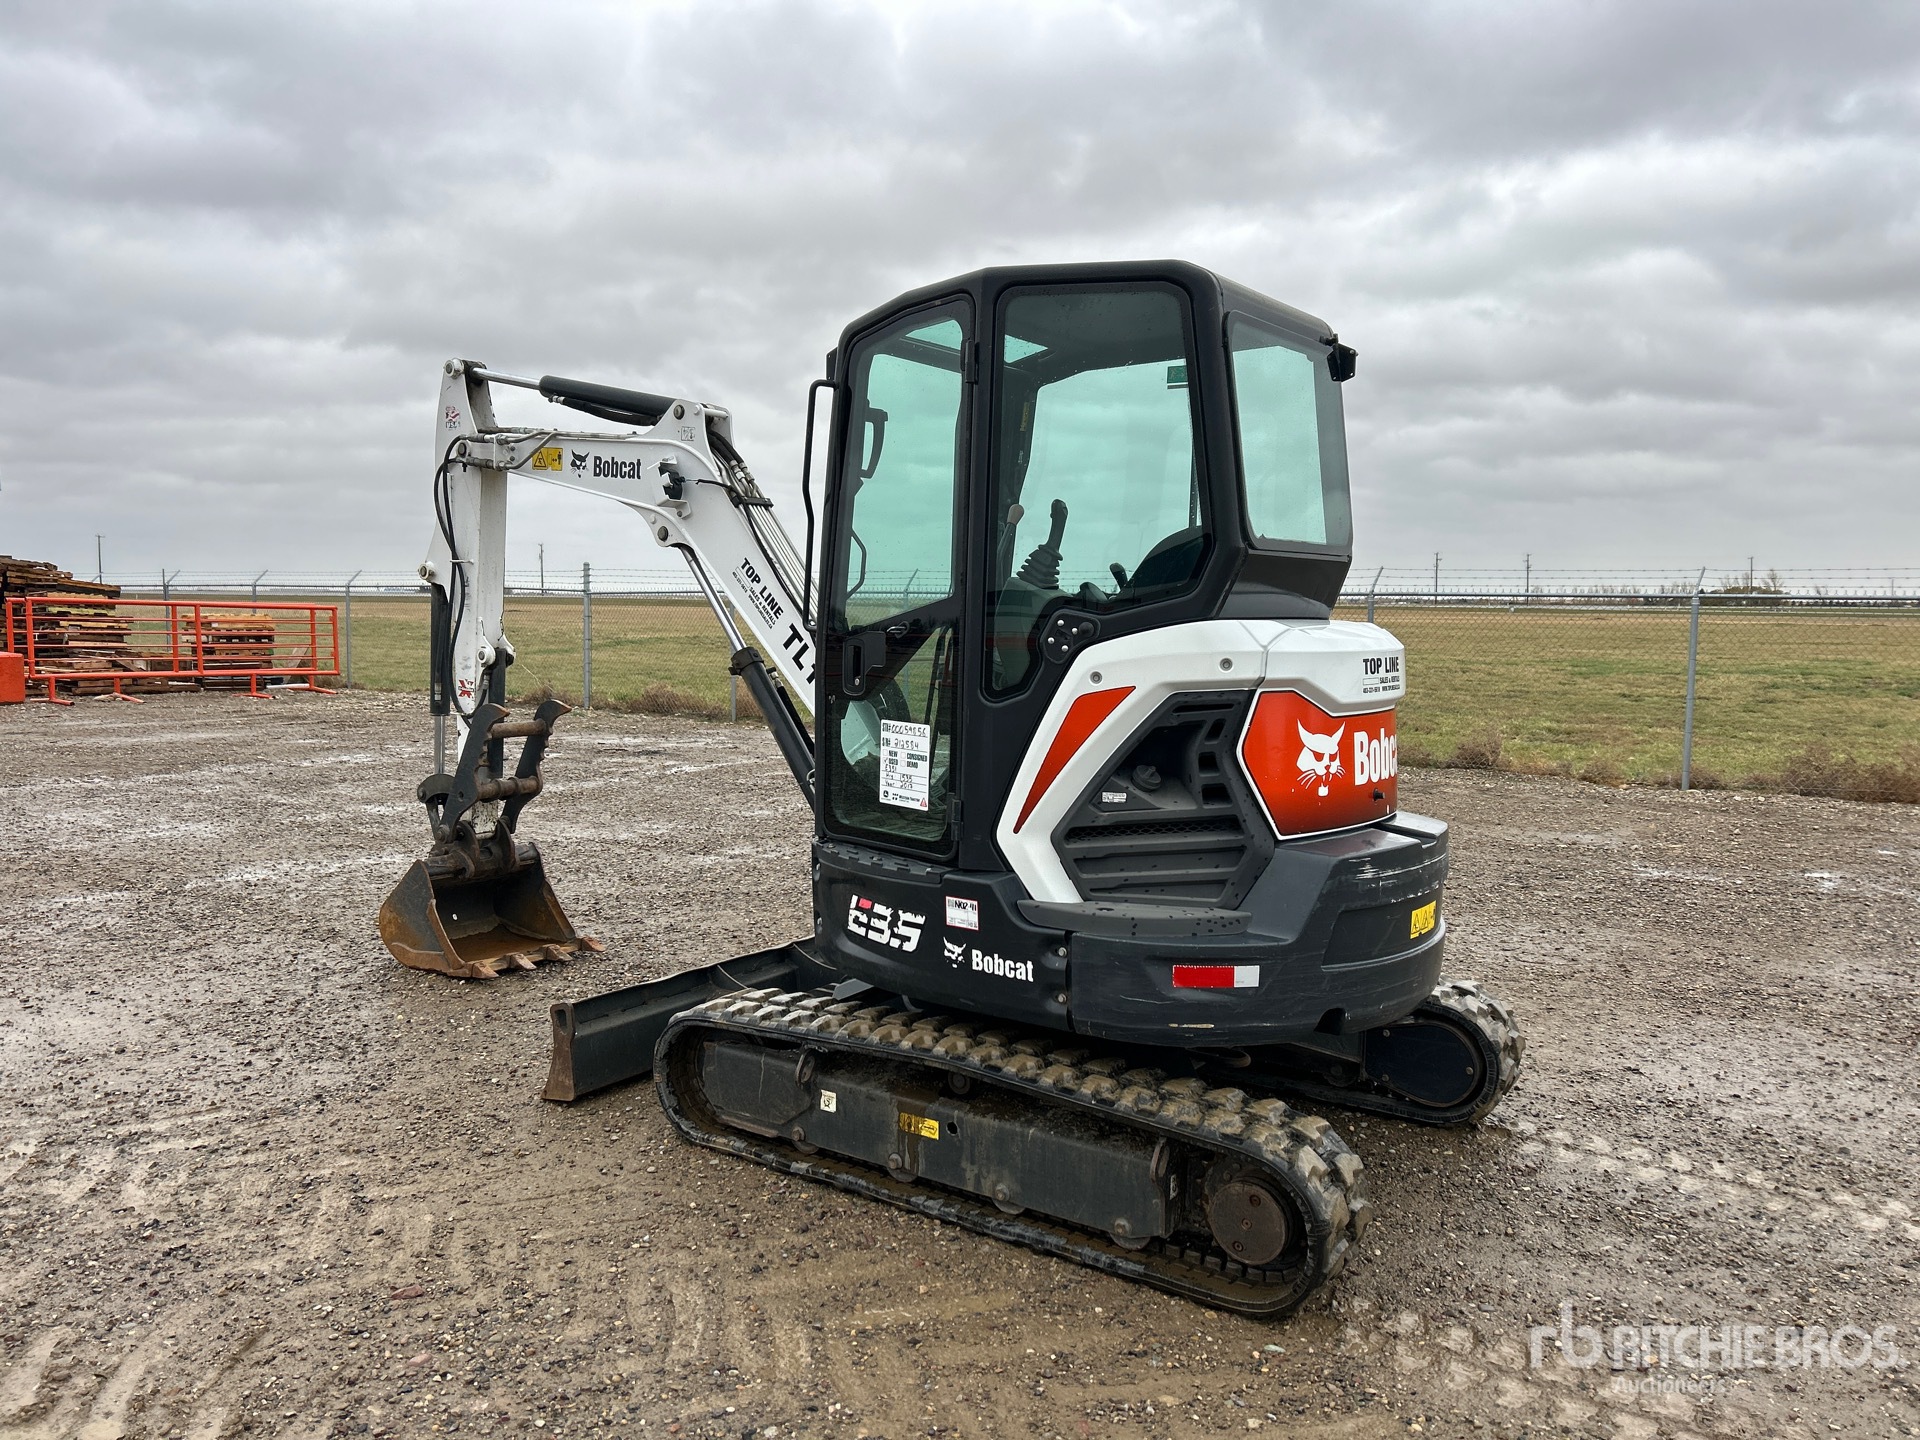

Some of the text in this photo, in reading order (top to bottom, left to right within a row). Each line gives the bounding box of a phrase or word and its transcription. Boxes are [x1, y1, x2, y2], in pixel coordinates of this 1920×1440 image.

[593, 456, 642, 480] Bobcat
[741, 557, 784, 620] TOP LINE
[1362, 656, 1399, 675] TOP LINE
[971, 949, 1034, 982] Bobcat
